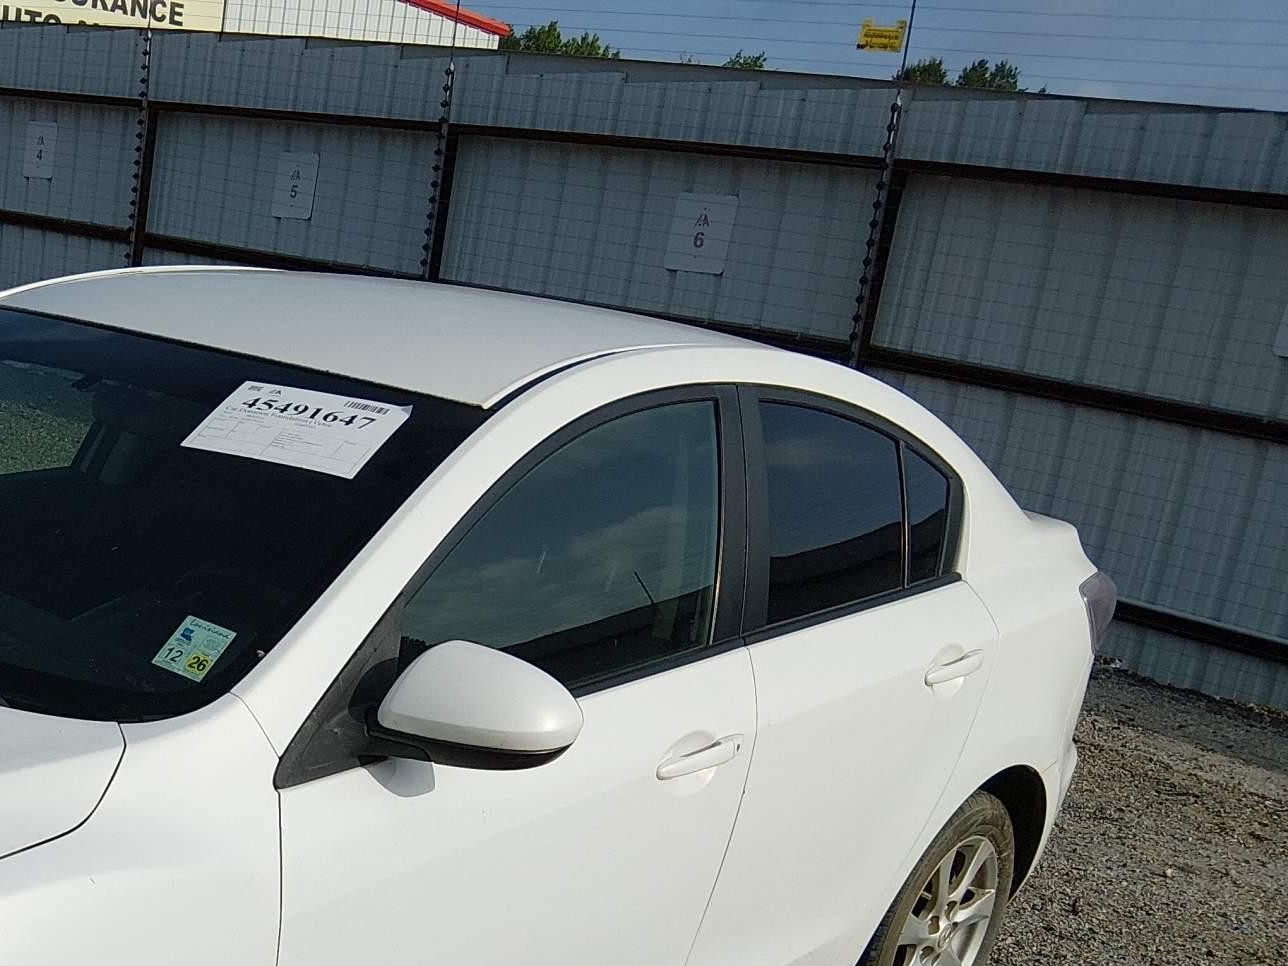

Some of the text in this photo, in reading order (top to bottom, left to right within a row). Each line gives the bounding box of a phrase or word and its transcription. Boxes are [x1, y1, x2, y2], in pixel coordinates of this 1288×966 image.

[55, 0, 185, 27] ANCE
[36, 149, 43, 161] 4
[289, 184, 299, 199] 5
[693, 231, 705, 249] 6
[242, 397, 377, 430] 45491647
[164, 647, 184, 663] 12
[187, 655, 209, 672] 26
